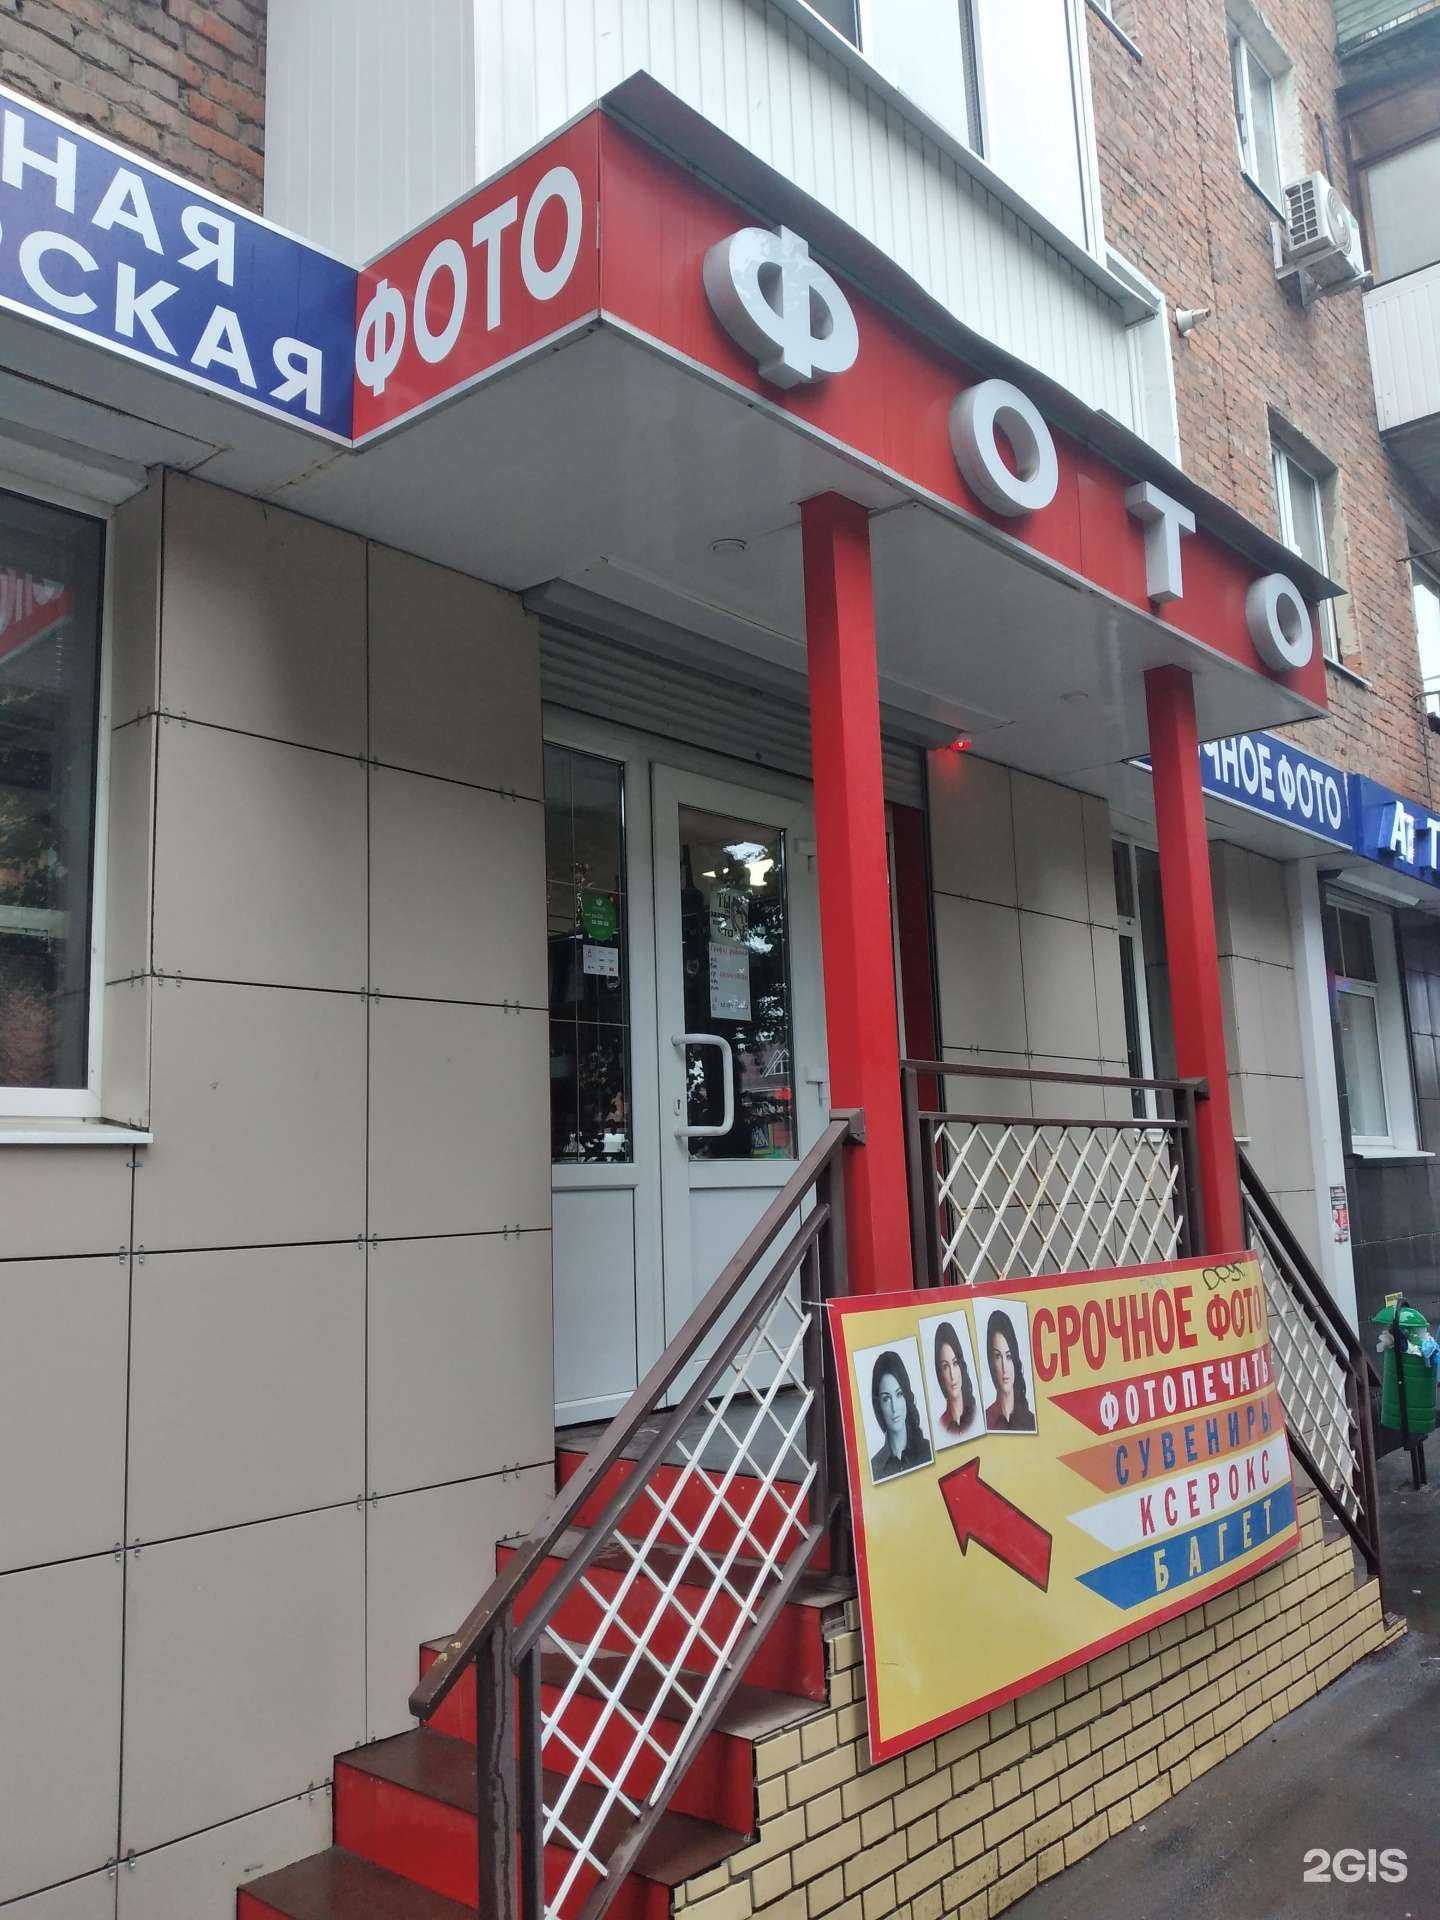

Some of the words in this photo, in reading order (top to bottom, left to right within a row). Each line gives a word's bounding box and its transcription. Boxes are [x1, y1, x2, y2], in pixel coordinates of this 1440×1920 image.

[2, 109, 236, 287] НАЯ
[0, 223, 323, 416] СКАЯ
[355, 166, 583, 397] ФОТО
[702, 225, 1314, 673] ФОТО
[1198, 735, 1275, 803] ЧНОЕ
[1277, 754, 1342, 830] ФОТО
[1033, 1285, 1198, 1383] СРОЧНОЕ
[1206, 1286, 1262, 1341] ФОТО
[1100, 1350, 1269, 1431] ФОТОПЕЧАТЬ
[1115, 1396, 1272, 1485] СУВЕНИРЫ
[1139, 1450, 1270, 1536] КСЕРОКС
[1153, 1499, 1272, 1592] БАГЕТ
